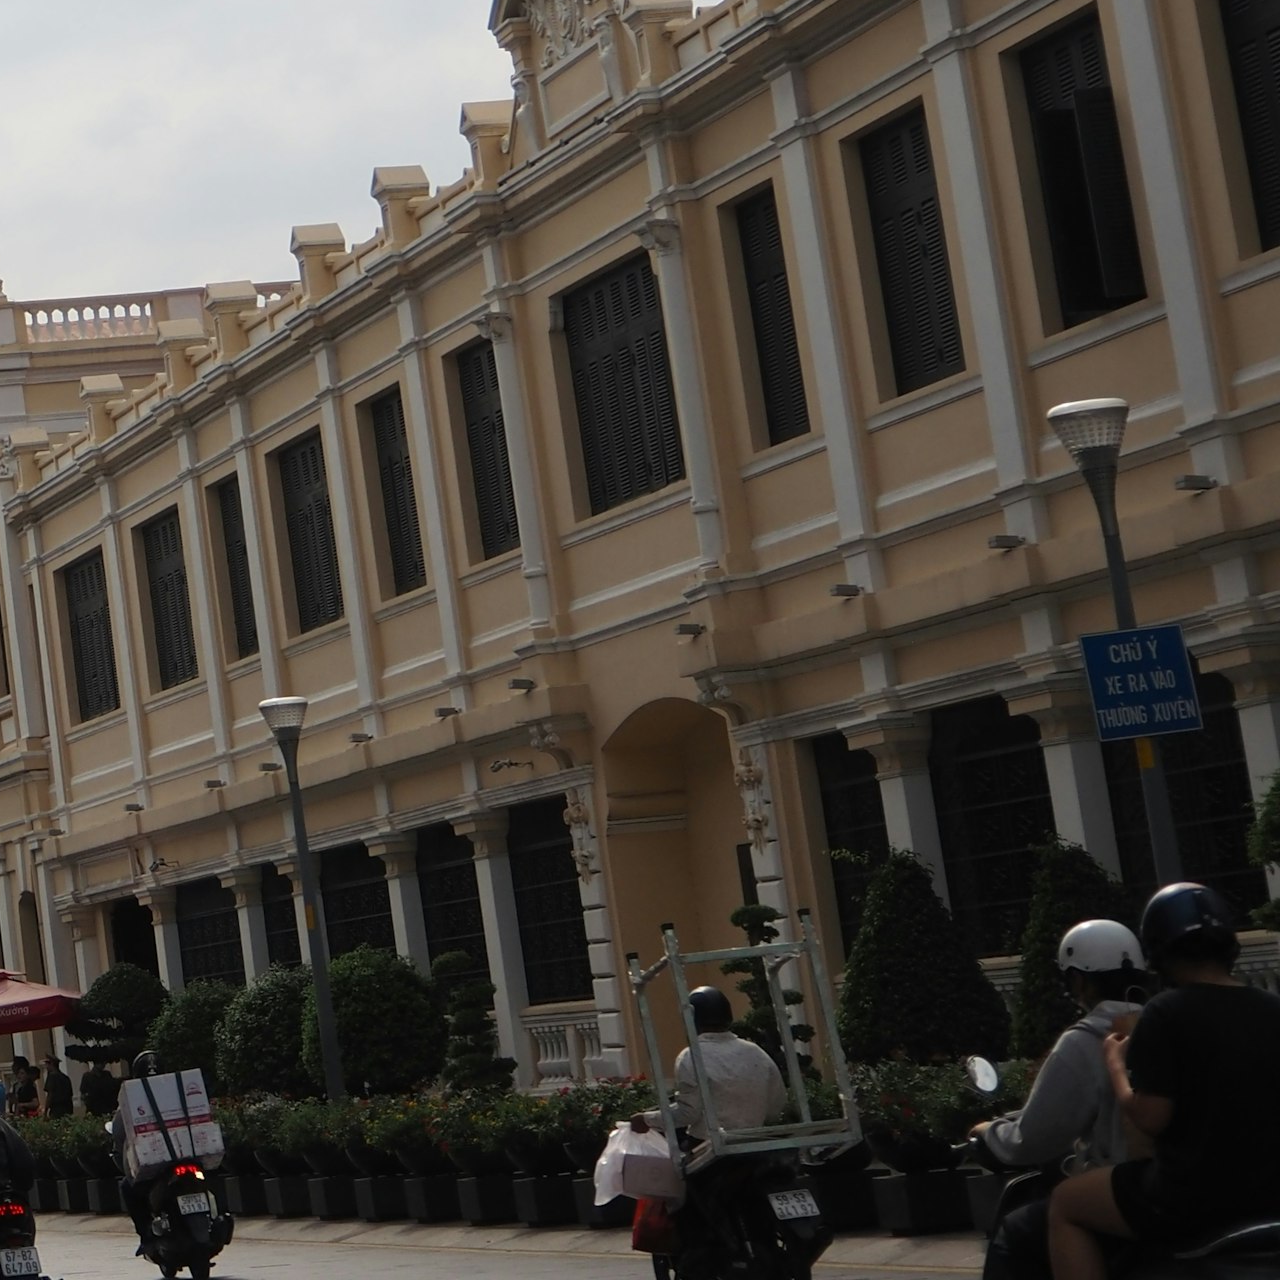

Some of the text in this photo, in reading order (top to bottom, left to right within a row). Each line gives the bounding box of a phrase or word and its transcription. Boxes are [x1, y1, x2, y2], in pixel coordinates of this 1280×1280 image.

[1109, 635, 1158, 664] CHÚ Ý
[1105, 666, 1176, 696] XE RA VÀO
[1097, 695, 1197, 729] THƯỜNG XUYÊN
[6, 1261, 39, 1274] 647.09
